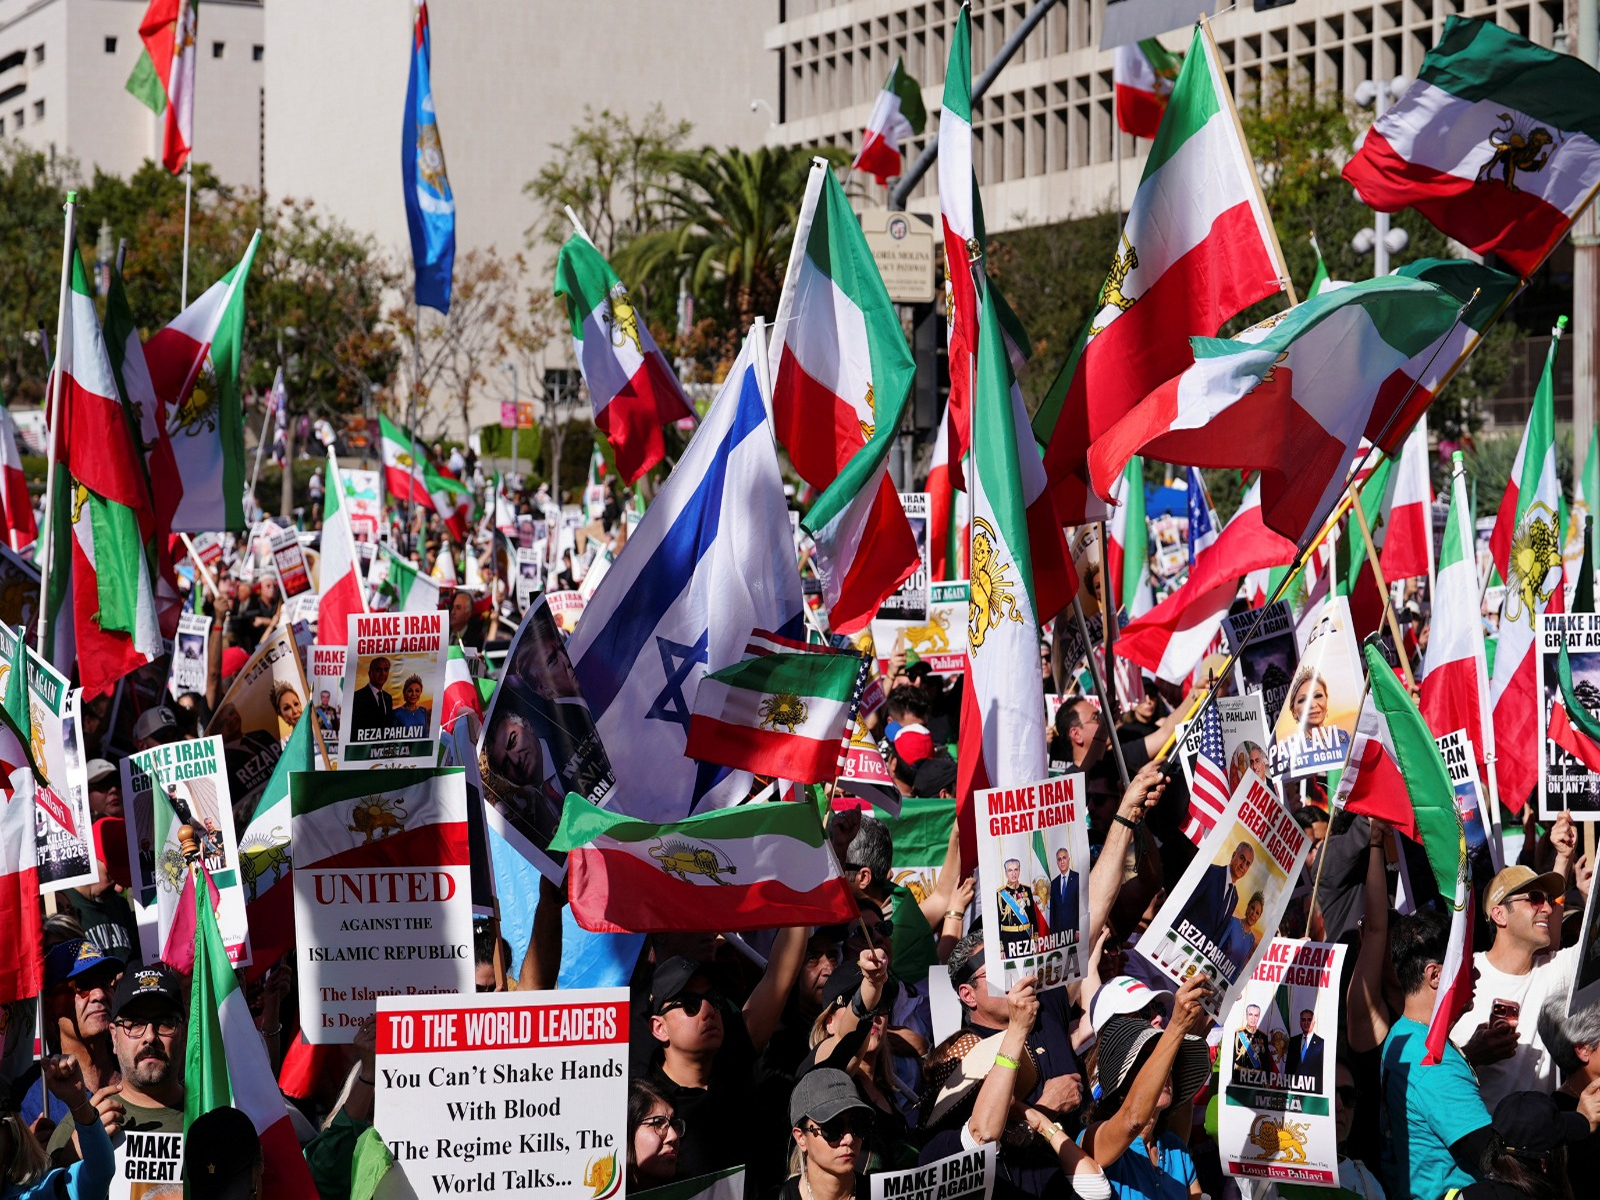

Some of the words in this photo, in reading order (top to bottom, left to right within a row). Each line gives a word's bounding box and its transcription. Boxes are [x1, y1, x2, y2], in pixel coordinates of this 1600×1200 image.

[357, 617, 401, 637] MAKE
[404, 615, 441, 635] IRAN
[1263, 616, 1290, 635] AGAIN
[1544, 615, 1585, 632] MAKE
[0, 632, 14, 660] RAN
[357, 637, 398, 655] GREAT
[400, 635, 440, 653] AGAIN
[1544, 632, 1583, 648] GRAT
[314, 651, 345, 663] MAKE
[930, 654, 964, 670] Pahlavi
[314, 665, 343, 676] GREAT
[1226, 711, 1257, 722] PAHLAVI
[357, 728, 382, 741] REZA
[383, 725, 424, 740] PAHLAVI
[1269, 725, 1341, 766] PAHLAVI
[130, 747, 172, 776] MAKE
[175, 739, 215, 763] IRAN
[235, 748, 272, 784] REZA
[858, 753, 883, 774] live
[1313, 749, 1343, 763] AGAIN
[131, 768, 170, 793] GRAT
[175, 759, 217, 781] AGAIN
[1548, 781, 1560, 793] ON
[587, 777, 610, 806] RAN
[988, 791, 1036, 815] MAKE
[1039, 779, 1074, 803] IRAN
[989, 812, 1034, 837] GREAT
[1037, 803, 1075, 827] AGAIN
[1246, 780, 1283, 826] MAKE
[1277, 809, 1305, 856] IRAN
[1238, 802, 1272, 843] GREAT
[1267, 833, 1296, 874] AGAIN
[60, 845, 84, 860] 2026
[312, 872, 456, 905] UNITED
[340, 918, 402, 931] AGAINST
[404, 917, 432, 929] THE
[309, 946, 380, 962] ISLAMIC
[384, 944, 468, 960] REPUBLIC
[1008, 938, 1037, 958] REZA
[1037, 929, 1074, 952] PAHLAVI
[1178, 919, 1208, 951] REZA
[1204, 939, 1237, 979] PAHLAVI
[1292, 945, 1336, 968] IRAN
[1003, 945, 1081, 995] MIGA
[1250, 963, 1284, 983] REAT
[1285, 966, 1331, 988] AGAIN
[320, 987, 347, 1002] The
[322, 1013, 334, 1028] Is
[389, 1016, 414, 1049] TO
[422, 1014, 458, 1048] THE
[465, 1011, 532, 1046] WORLD
[538, 1007, 616, 1043] LEADERS
[381, 1068, 421, 1089] You
[428, 1065, 487, 1088] Can’t
[493, 1062, 554, 1085] Shake
[560, 1058, 623, 1081] Hands
[1240, 1069, 1267, 1086] REZA
[1269, 1072, 1316, 1091] PAHLAVI
[446, 1100, 496, 1122] With
[504, 1097, 561, 1119] Blood
[126, 1134, 182, 1159] MAKE
[388, 1140, 429, 1161] The
[436, 1137, 512, 1162] Regime
[519, 1131, 570, 1153] Kills,
[576, 1129, 614, 1150] The
[125, 1160, 178, 1181] GREAT
[432, 1172, 495, 1195] World
[502, 1169, 572, 1191] Talks...
[883, 1166, 938, 1198] MAKE
[941, 1150, 986, 1183] IRAN
[1242, 1164, 1267, 1177] Long
[1268, 1167, 1286, 1178] live
[1287, 1169, 1324, 1181] Pahlavi
[936, 1171, 985, 1200] AGAIN
